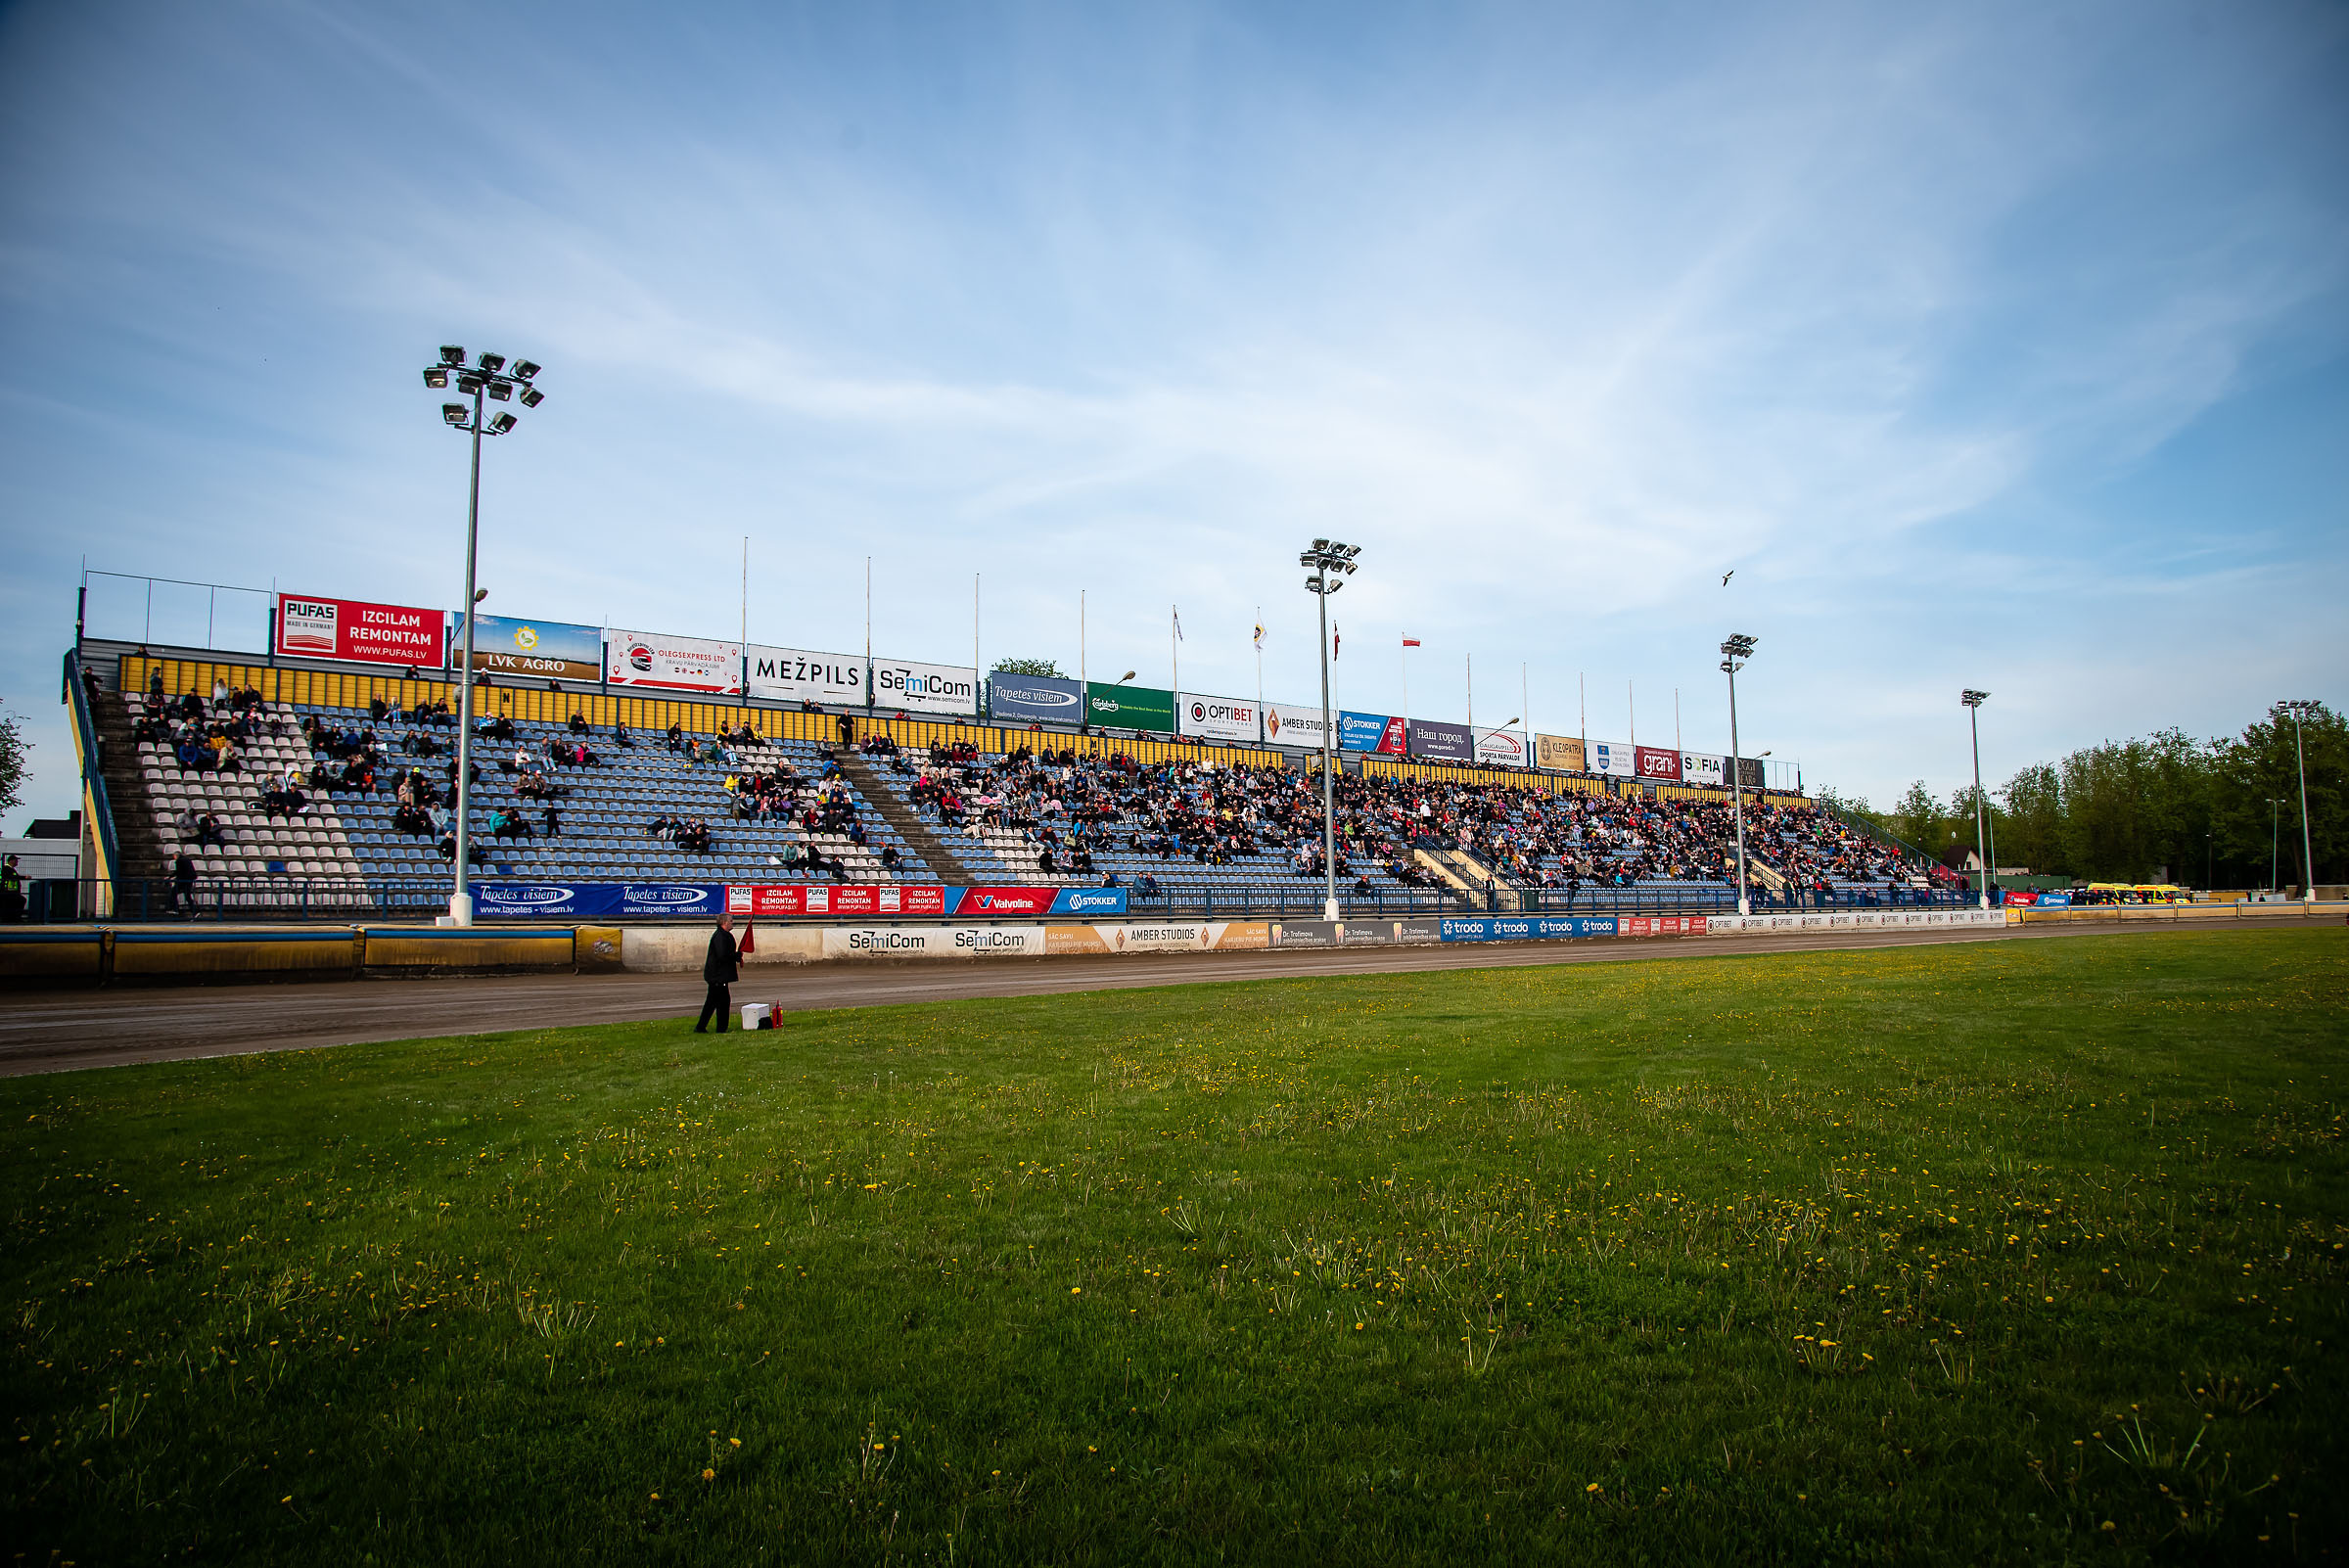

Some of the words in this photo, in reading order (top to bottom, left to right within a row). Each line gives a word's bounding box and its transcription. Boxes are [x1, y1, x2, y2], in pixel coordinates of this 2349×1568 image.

[287, 602, 335, 619] PUFAS
[362, 610, 420, 627] IZCILAM
[349, 626, 432, 645] REMONTAM
[354, 645, 427, 659] WWW.PUFAS.LV
[658, 649, 712, 662] OLEGSEXPRESS
[488, 654, 517, 669] LVK
[523, 658, 566, 672] AGRO
[756, 657, 859, 686] MEŽPILS
[880, 669, 971, 697] SemiCom
[927, 695, 971, 705] www.semicom.lv
[994, 685, 1032, 701] Tapetes
[1034, 691, 1063, 703] visiem
[1092, 697, 1119, 712] Carlsberg
[1209, 705, 1252, 721] OPTIBET
[1282, 716, 1305, 729] AMBER
[1306, 719, 1333, 731] STUDS
[1353, 720, 1380, 730] STOKKER
[1416, 727, 1437, 740] Наш
[1480, 742, 1514, 752] DAUGAVPILS
[1552, 742, 1582, 755] KLEOPATRA
[1480, 751, 1497, 760] SPORTA
[1497, 752, 1520, 761] PĀRVALDE
[1644, 755, 1673, 775] grani
[1685, 757, 1721, 773] SOFIA
[480, 885, 518, 902] Tapetes
[523, 889, 558, 900] visiem
[622, 886, 658, 902] Tapetes
[663, 889, 693, 900] visiem
[992, 899, 1034, 908] Valvoline
[1082, 897, 1117, 905] STOKKER
[480, 905, 532, 914] www.tapetes
[622, 905, 670, 914] www.tapetes
[1454, 922, 1484, 934] trodo
[1503, 922, 1529, 933] trodo
[1548, 921, 1572, 932] trodo
[1590, 920, 1613, 931] trodo
[850, 932, 925, 948] SemiCom
[955, 931, 1025, 947] SemiCom
[1131, 929, 1159, 942] AMBER
[1161, 928, 1195, 940] STUDIOS
